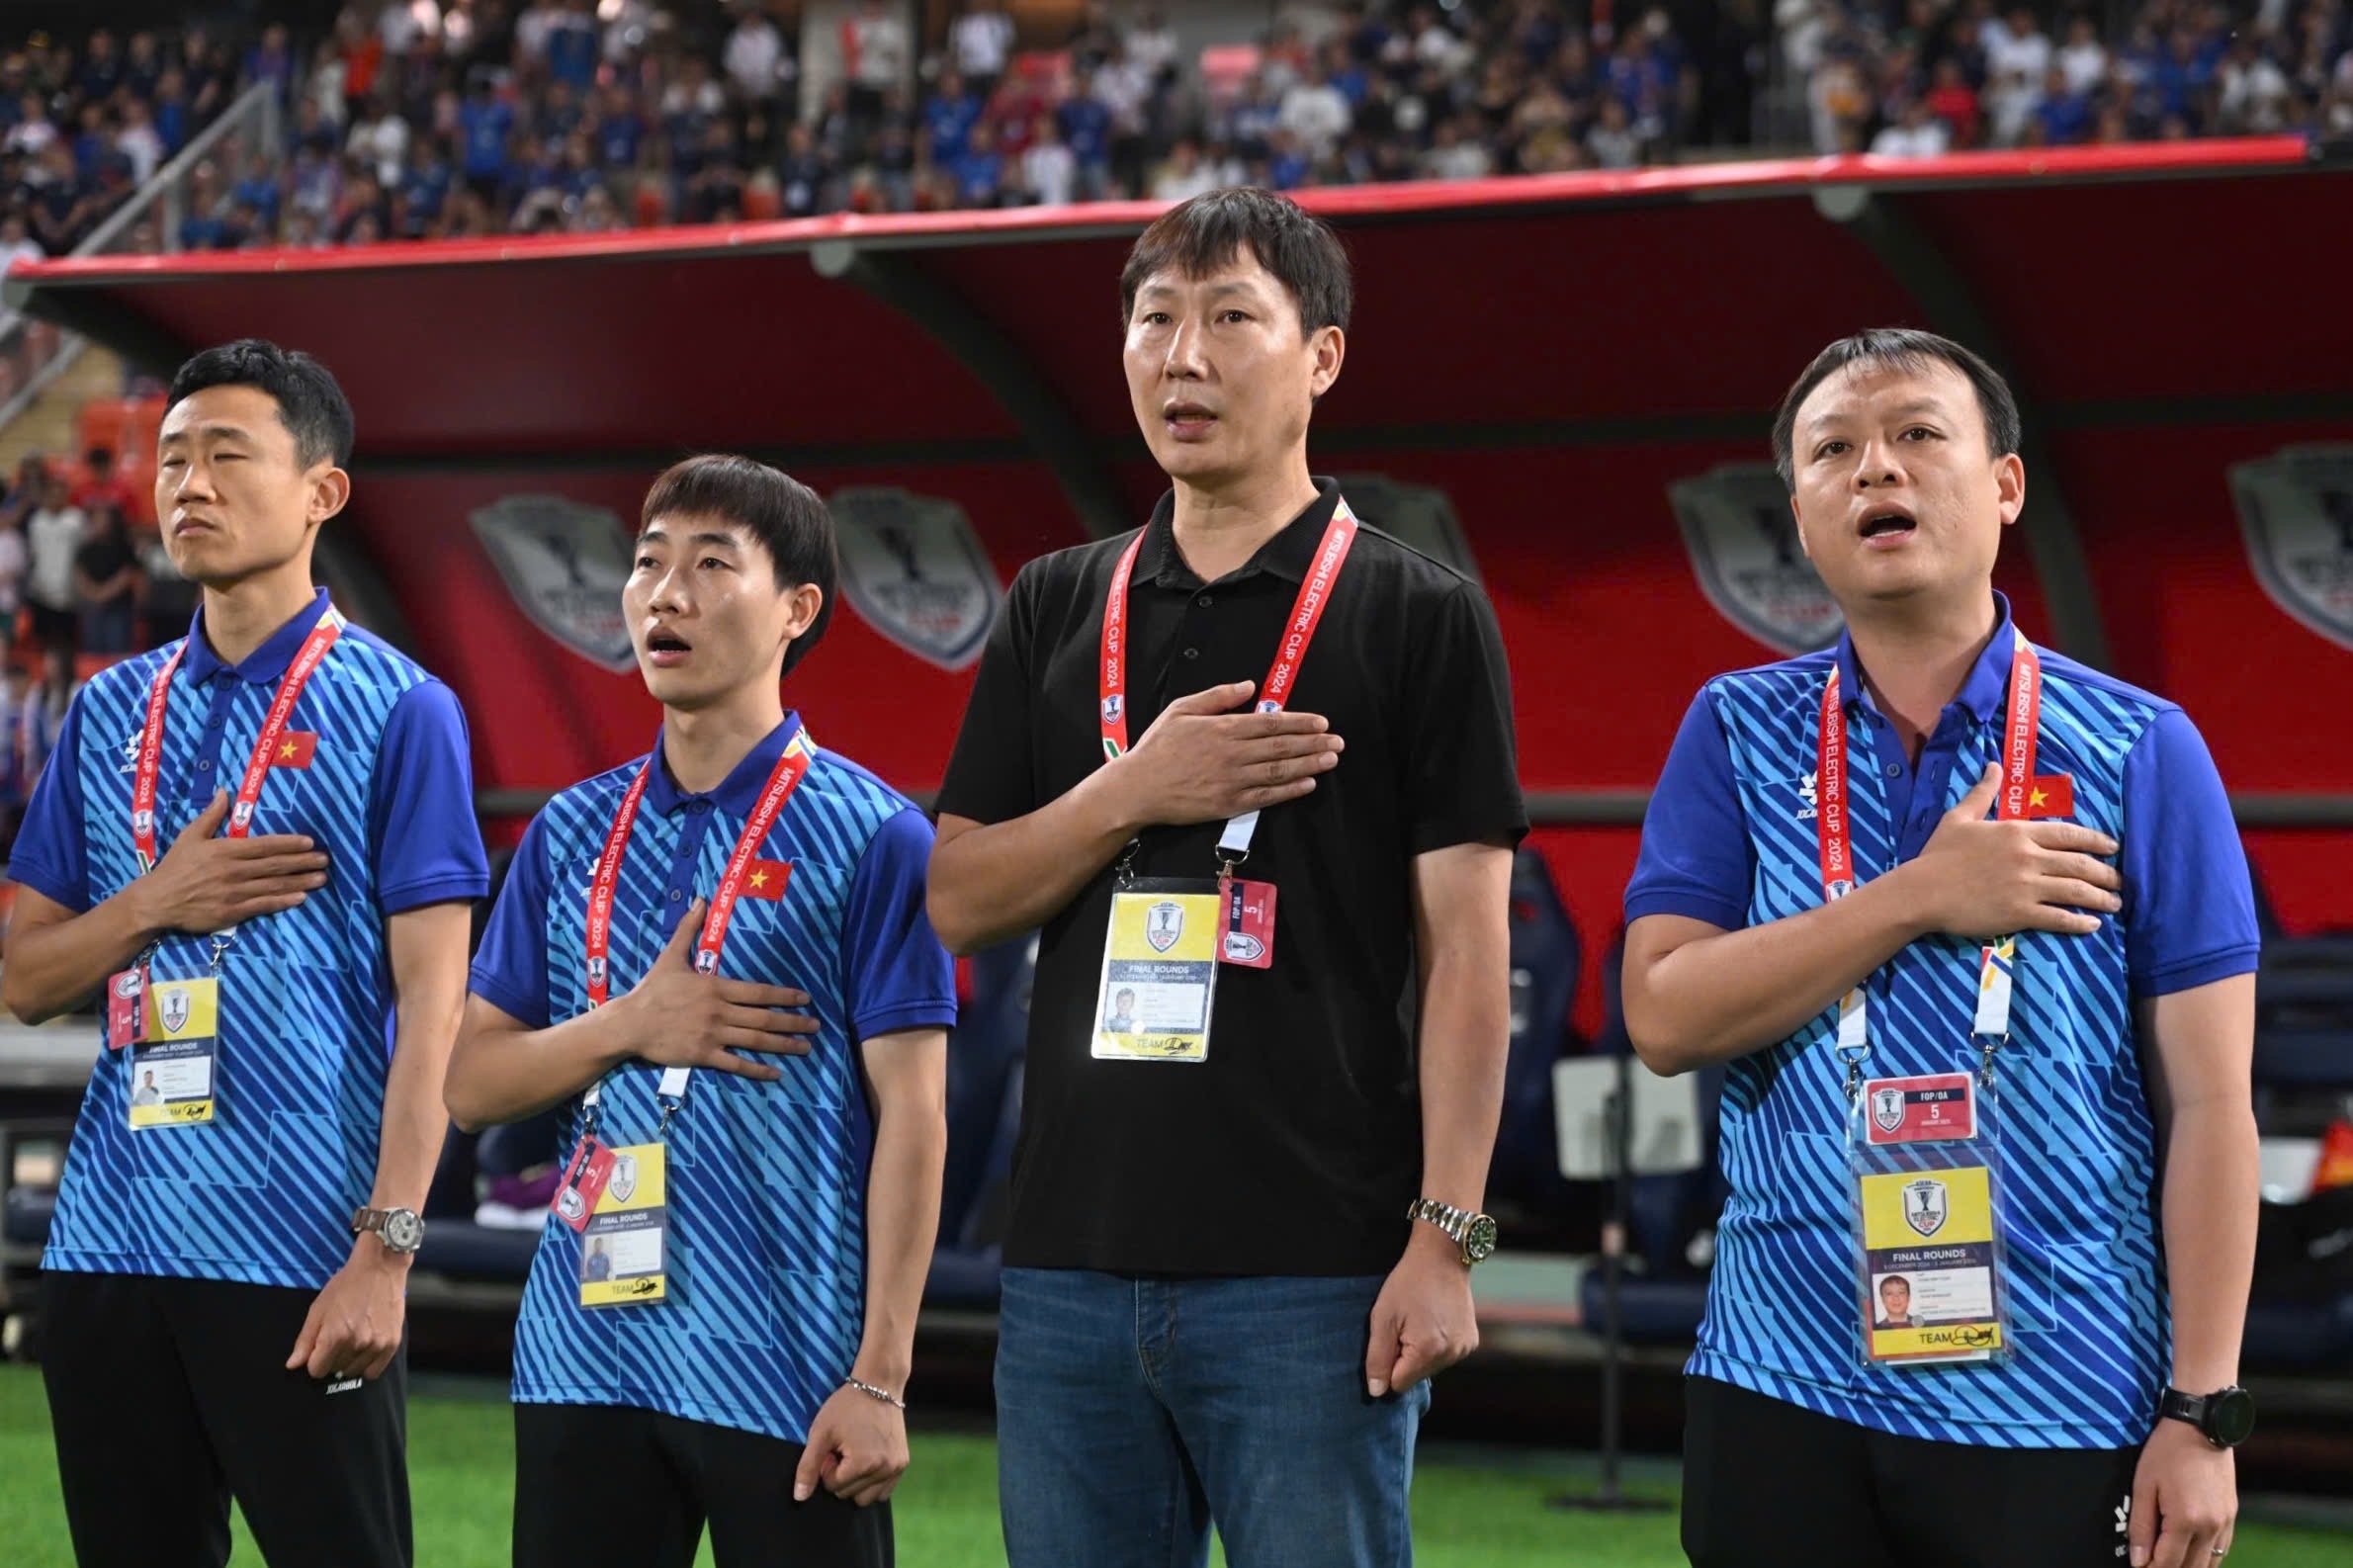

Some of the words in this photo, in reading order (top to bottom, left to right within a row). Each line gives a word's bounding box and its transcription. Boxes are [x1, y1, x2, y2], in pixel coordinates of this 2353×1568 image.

[1294, 576, 1325, 632] ELECTRIC
[1107, 626, 1120, 653] CUP
[1284, 633, 1303, 660] CUP
[1106, 657, 1118, 688] 2024
[1270, 662, 1290, 693] 2024
[2016, 662, 2032, 723] MITSUBISHI
[266, 685, 297, 737] ELECTRIC
[142, 747, 155, 773] CUP
[257, 738, 273, 764] CUP
[2011, 724, 2028, 783] ELECTRIC
[245, 766, 262, 795] 2024
[1825, 744, 1838, 802] ELECTRIC
[139, 776, 151, 804] 2024
[755, 767, 795, 826] MITSUBISHI
[2008, 785, 2023, 816] CUP
[1826, 804, 1841, 833] CUP
[599, 831, 624, 884] ELECTRIC
[729, 825, 762, 879] ELECTRIC
[1828, 837, 1844, 872] 2024
[594, 886, 608, 915] CUP
[719, 880, 736, 909] CUP
[1243, 906, 1259, 915] 5
[592, 916, 604, 949] 2024
[707, 912, 724, 942] 2024
[1920, 1090, 1949, 1101] FOP/OA
[1931, 1103, 1940, 1119] 5
[1892, 1252, 1921, 1263] FINAL
[1923, 1249, 1966, 1261] ROUNDS
[611, 1284, 634, 1295] TEAM
[1919, 1333, 1953, 1344] TEAM
